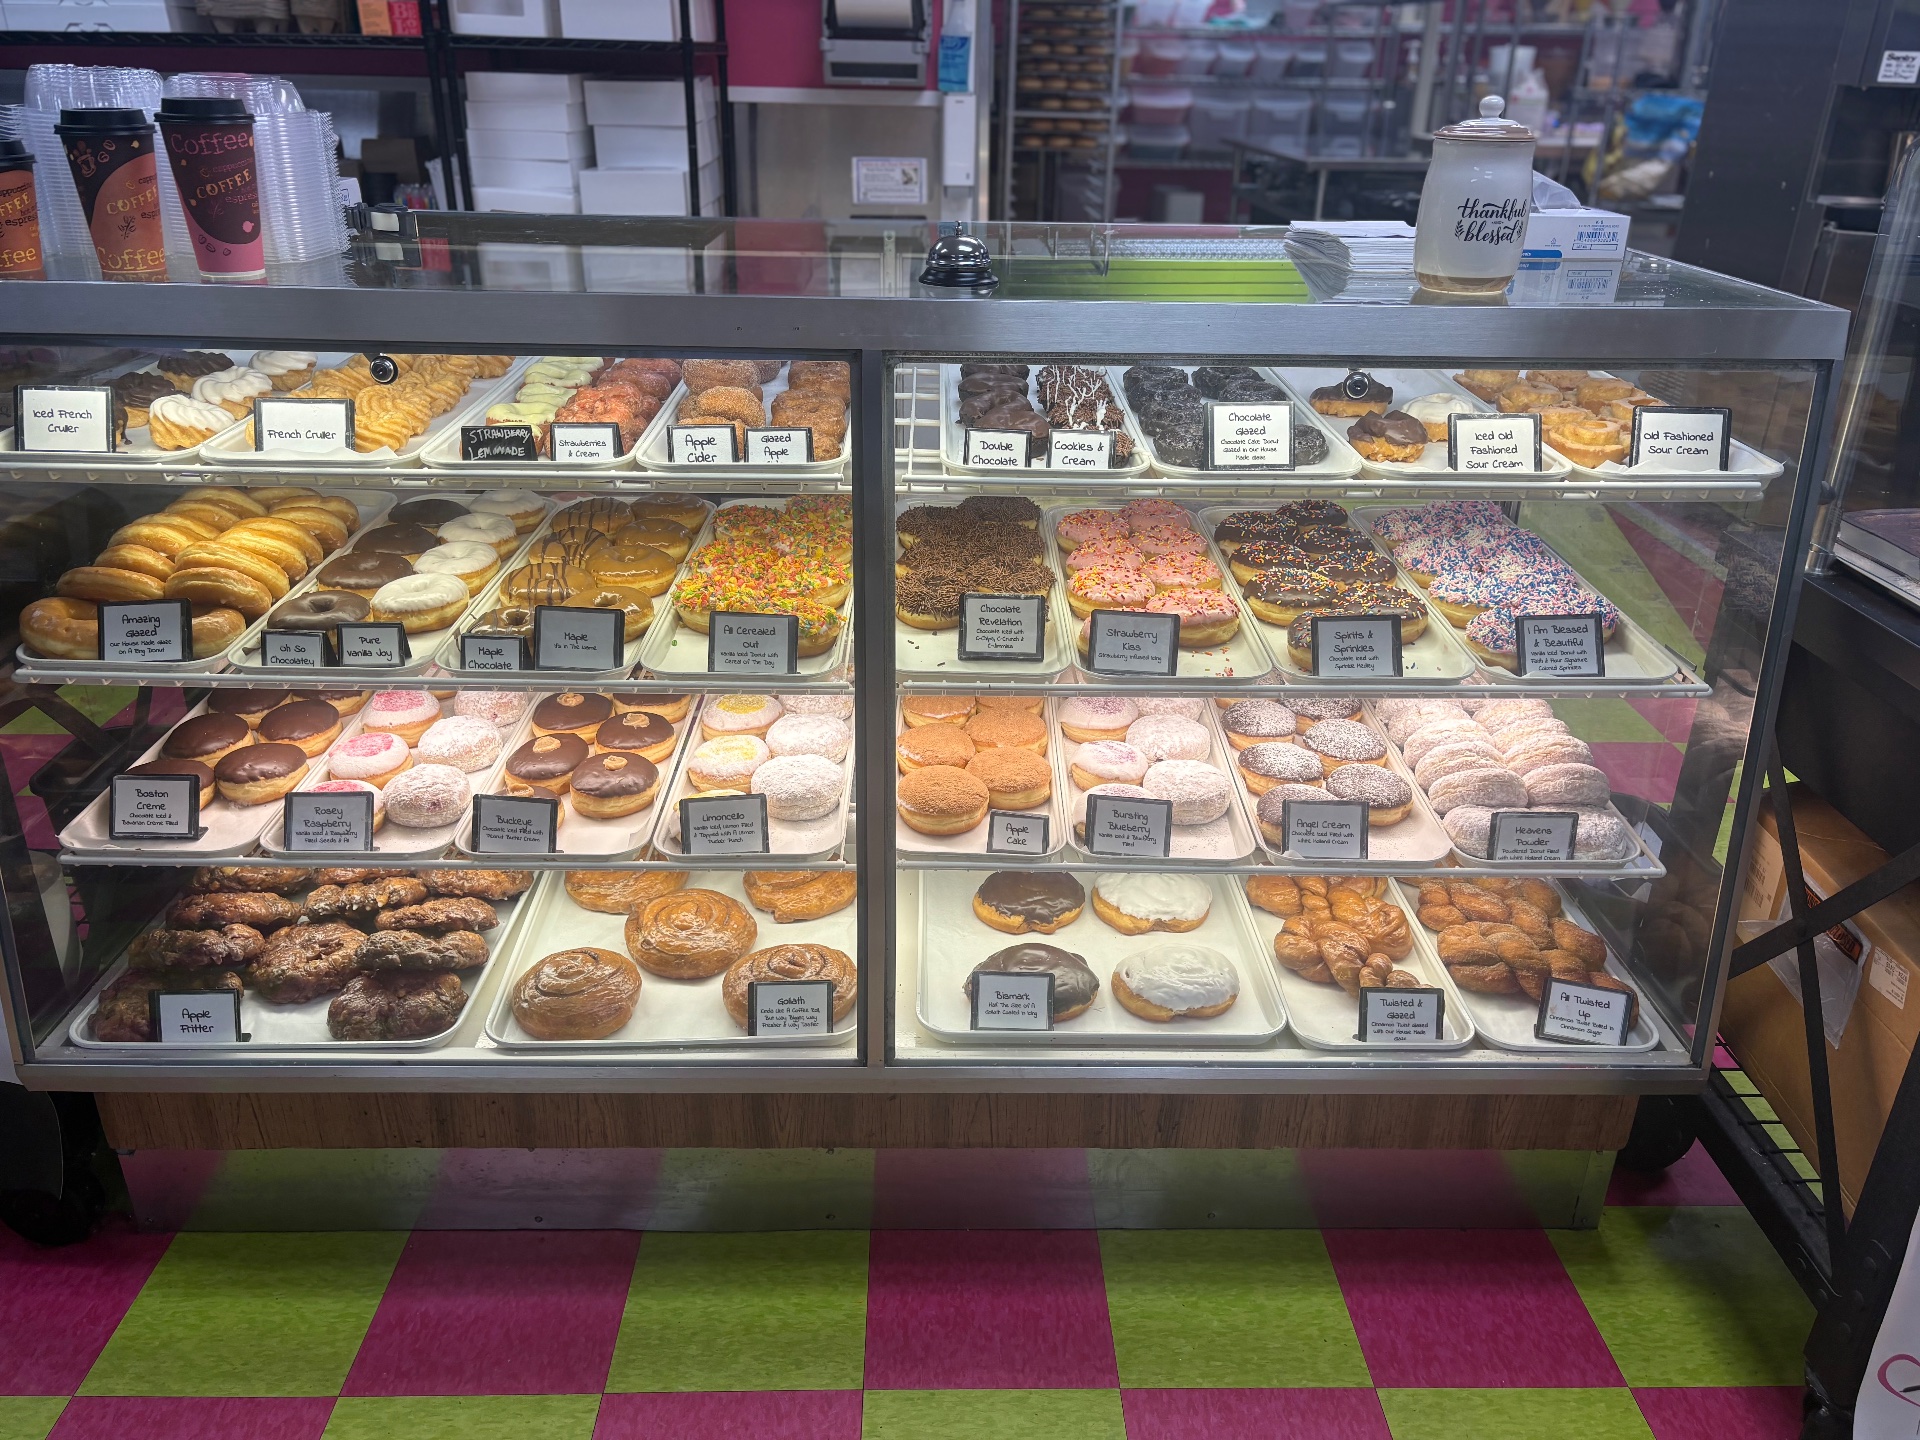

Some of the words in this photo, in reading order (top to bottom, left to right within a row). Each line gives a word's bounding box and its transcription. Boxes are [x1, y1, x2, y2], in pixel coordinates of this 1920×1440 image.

[171, 132, 248, 155] Coffee
[197, 168, 252, 199] COFFEE
[1457, 198, 1527, 221] thankful
[1464, 220, 1519, 245] blessed
[33, 408, 54, 418] Iced
[58, 409, 92, 419] French
[1228, 412, 1272, 422] Chocolate
[267, 429, 301, 439] French
[469, 427, 531, 444] STRAWBERRY
[1235, 425, 1267, 436] Glazed
[1475, 430, 1495, 441] Iced
[1663, 430, 1714, 442] Fashioned
[558, 439, 607, 447] Strawberries
[685, 434, 718, 451] Apple
[761, 433, 792, 444] Glazed
[980, 440, 1015, 452] Double
[1054, 441, 1094, 451] Cookies
[1097, 442, 1105, 452] &
[1469, 443, 1519, 455] Fashioned
[1648, 444, 1674, 455] Sour
[1676, 445, 1709, 456] Cream
[468, 446, 526, 461] LEMONADE
[575, 450, 600, 458] Cream
[687, 452, 717, 463] Cider
[763, 446, 790, 460] Apple
[972, 456, 1019, 467] Chocolate
[1062, 456, 1096, 466] Cream
[1465, 459, 1489, 470] Sour
[1491, 459, 1524, 470] Cream
[980, 604, 1022, 614] Chocolate
[121, 614, 161, 629] Amazing
[979, 617, 1023, 626] Revelation
[125, 627, 158, 638] Glazed
[736, 626, 776, 636] Cerealed
[1533, 625, 1548, 635] Am
[1551, 624, 1589, 634] Blessed
[358, 636, 382, 645] Pure
[564, 632, 589, 645] Maple
[1106, 628, 1158, 645] Strawberry
[1334, 631, 1365, 643] Spirits
[1367, 630, 1374, 639] &
[1122, 642, 1142, 651] Kiss
[1533, 639, 1540, 648] &
[1543, 638, 1584, 648] Beautiful
[294, 645, 306, 653] So
[375, 648, 393, 661] Joy
[478, 646, 505, 660] Maple
[1333, 644, 1375, 656] Sprinkles
[270, 656, 315, 667] Chocolatey
[467, 659, 513, 670] Chocolate
[135, 788, 169, 798] Boston
[314, 806, 344, 820] Rosey
[702, 812, 745, 822] Limoncello
[1112, 809, 1149, 826] Bursting
[303, 819, 352, 833] Raspberry
[495, 815, 533, 830] Buckeye
[1296, 818, 1319, 833] Angel
[1321, 821, 1351, 830] Cream
[1005, 822, 1030, 837] Apple
[1107, 821, 1151, 838] Blueberry
[1515, 826, 1552, 835] Heavens
[1006, 836, 1027, 846] Cake
[1515, 837, 1550, 846] Powder
[777, 996, 806, 1005] Goliath
[995, 990, 1030, 1000] Bismark
[1379, 998, 1415, 1007] Twisted
[1417, 999, 1424, 1008] &
[1573, 995, 1611, 1009] Twisted
[182, 1008, 212, 1023] Apple
[1386, 1011, 1416, 1020] Glazed
[1578, 1009, 1591, 1020] Up
[180, 1024, 214, 1033] Fritter
